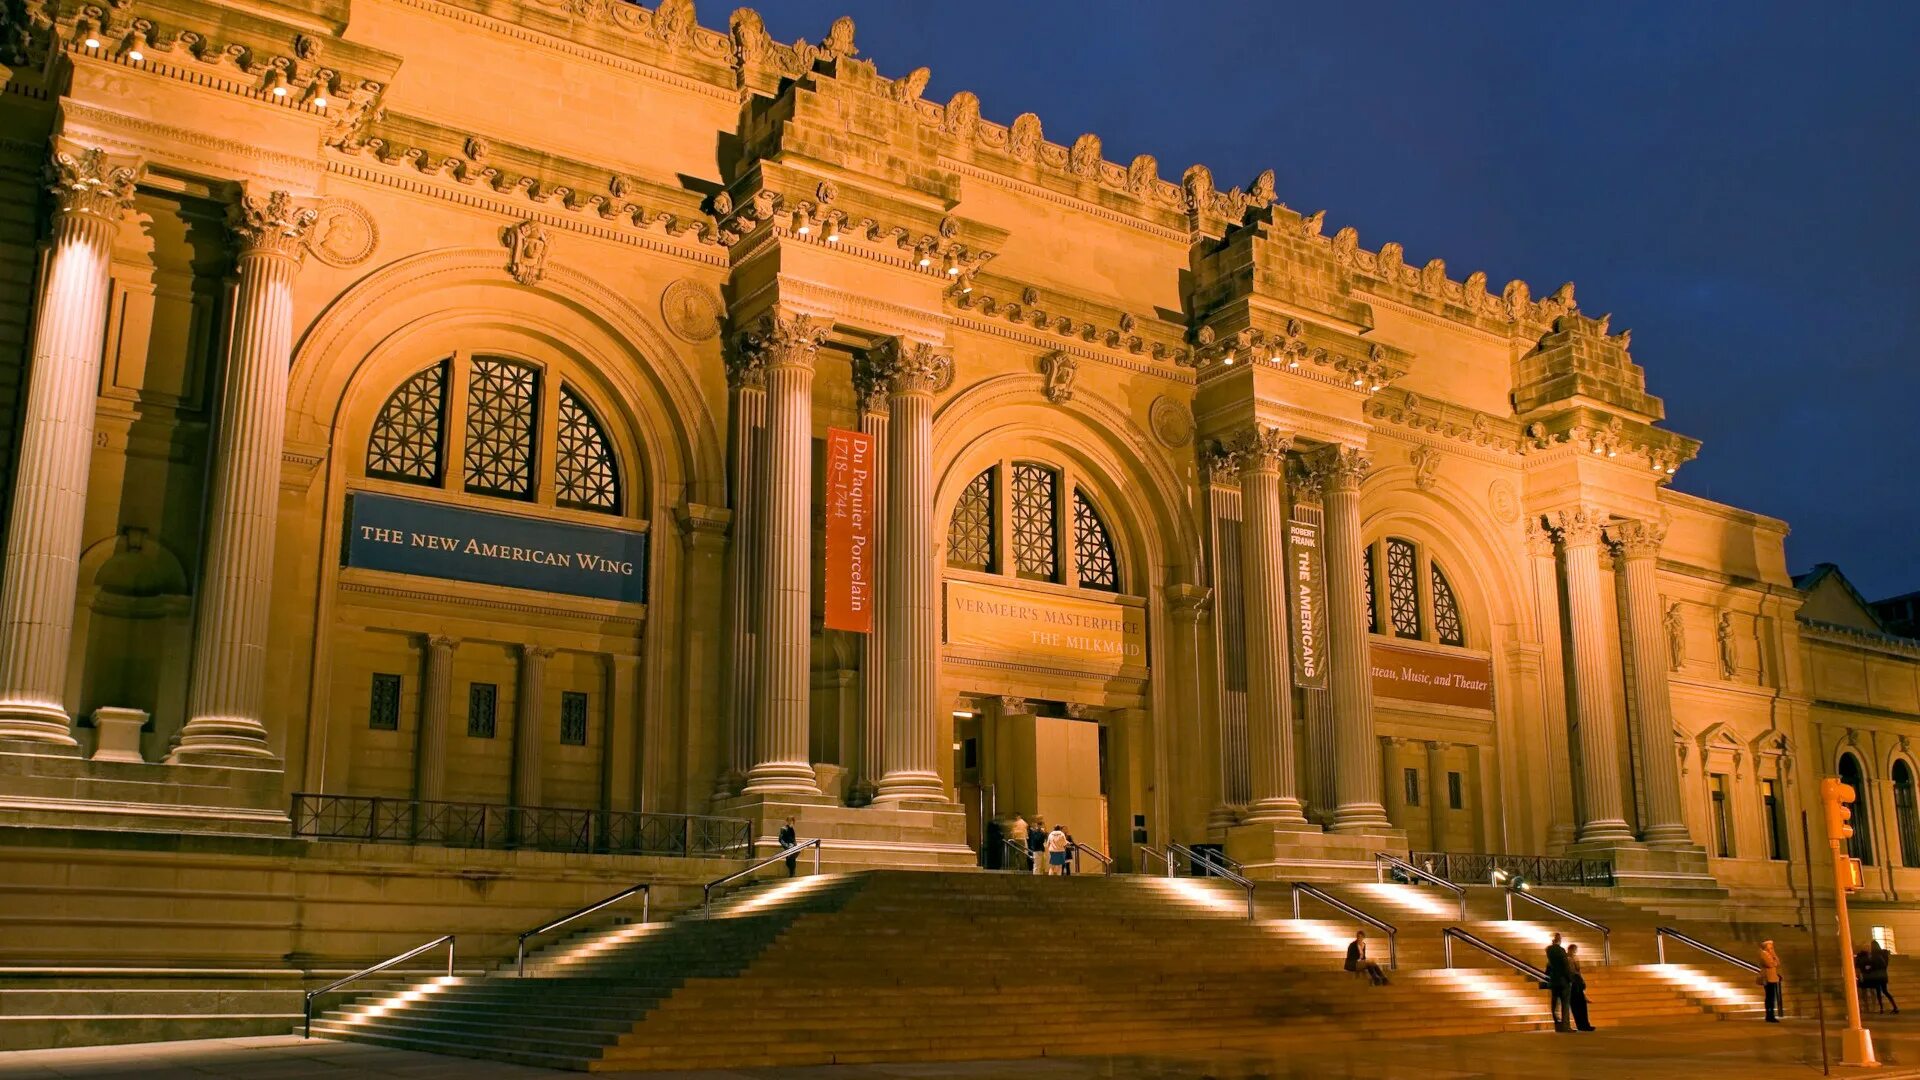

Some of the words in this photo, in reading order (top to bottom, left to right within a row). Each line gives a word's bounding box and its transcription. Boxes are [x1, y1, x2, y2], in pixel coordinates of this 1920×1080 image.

[853, 438, 868, 464] Du
[850, 469, 867, 530] Paquier
[1290, 526, 1315, 537] ROBERT
[1291, 535, 1316, 547] FRANK
[361, 525, 403, 544] THE
[411, 532, 459, 551] NEW
[464, 538, 571, 567] AMERICAN
[576, 552, 633, 576] WING
[851, 534, 867, 611] Porcelain
[1298, 551, 1310, 581] THE
[955, 597, 1039, 620] VERMEER'S
[1044, 610, 1139, 634] MASTERPIECE
[1031, 630, 1060, 646] THE
[1066, 636, 1140, 656] MILKMAID
[1299, 584, 1315, 678] AMERICANS
[1401, 666, 1432, 685] Music,
[1433, 673, 1451, 687] and
[1453, 674, 1488, 690] Theater
